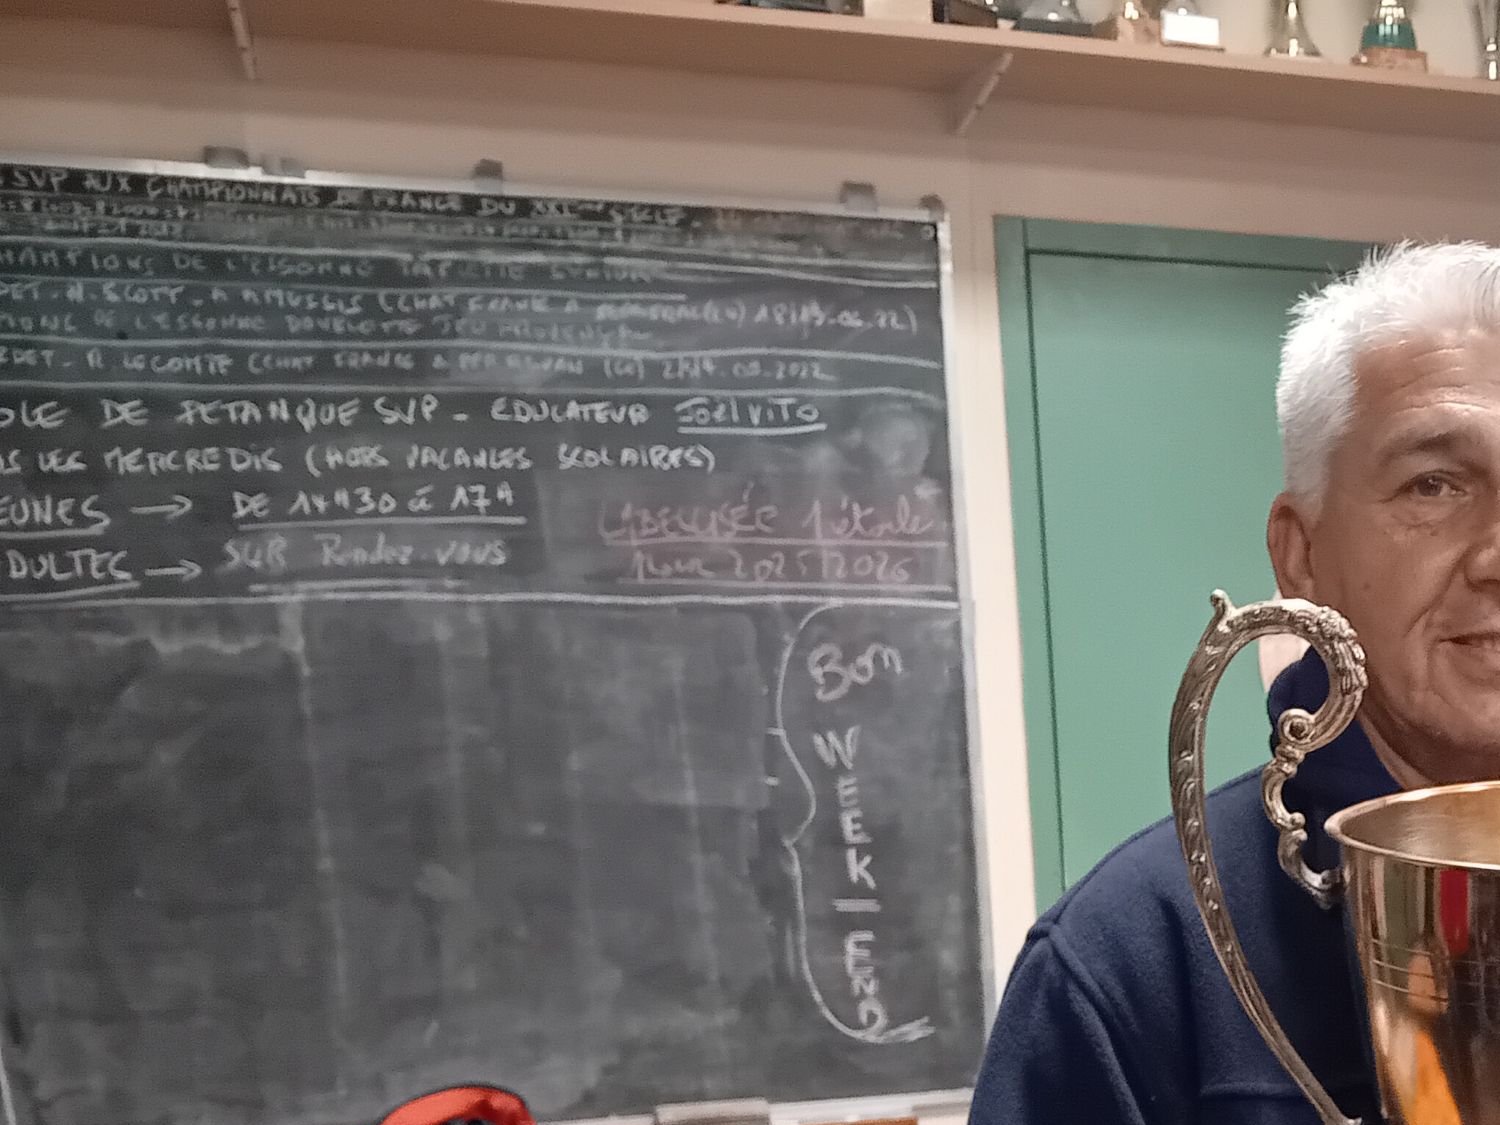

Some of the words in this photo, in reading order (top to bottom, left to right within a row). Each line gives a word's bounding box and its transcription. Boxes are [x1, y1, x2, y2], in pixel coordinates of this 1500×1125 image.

[13, 167, 67, 193] SVP
[101, 399, 148, 427] DE
[374, 394, 439, 425] SVP
[491, 397, 650, 426] EDUCATEUR
[231, 490, 270, 519] DE
